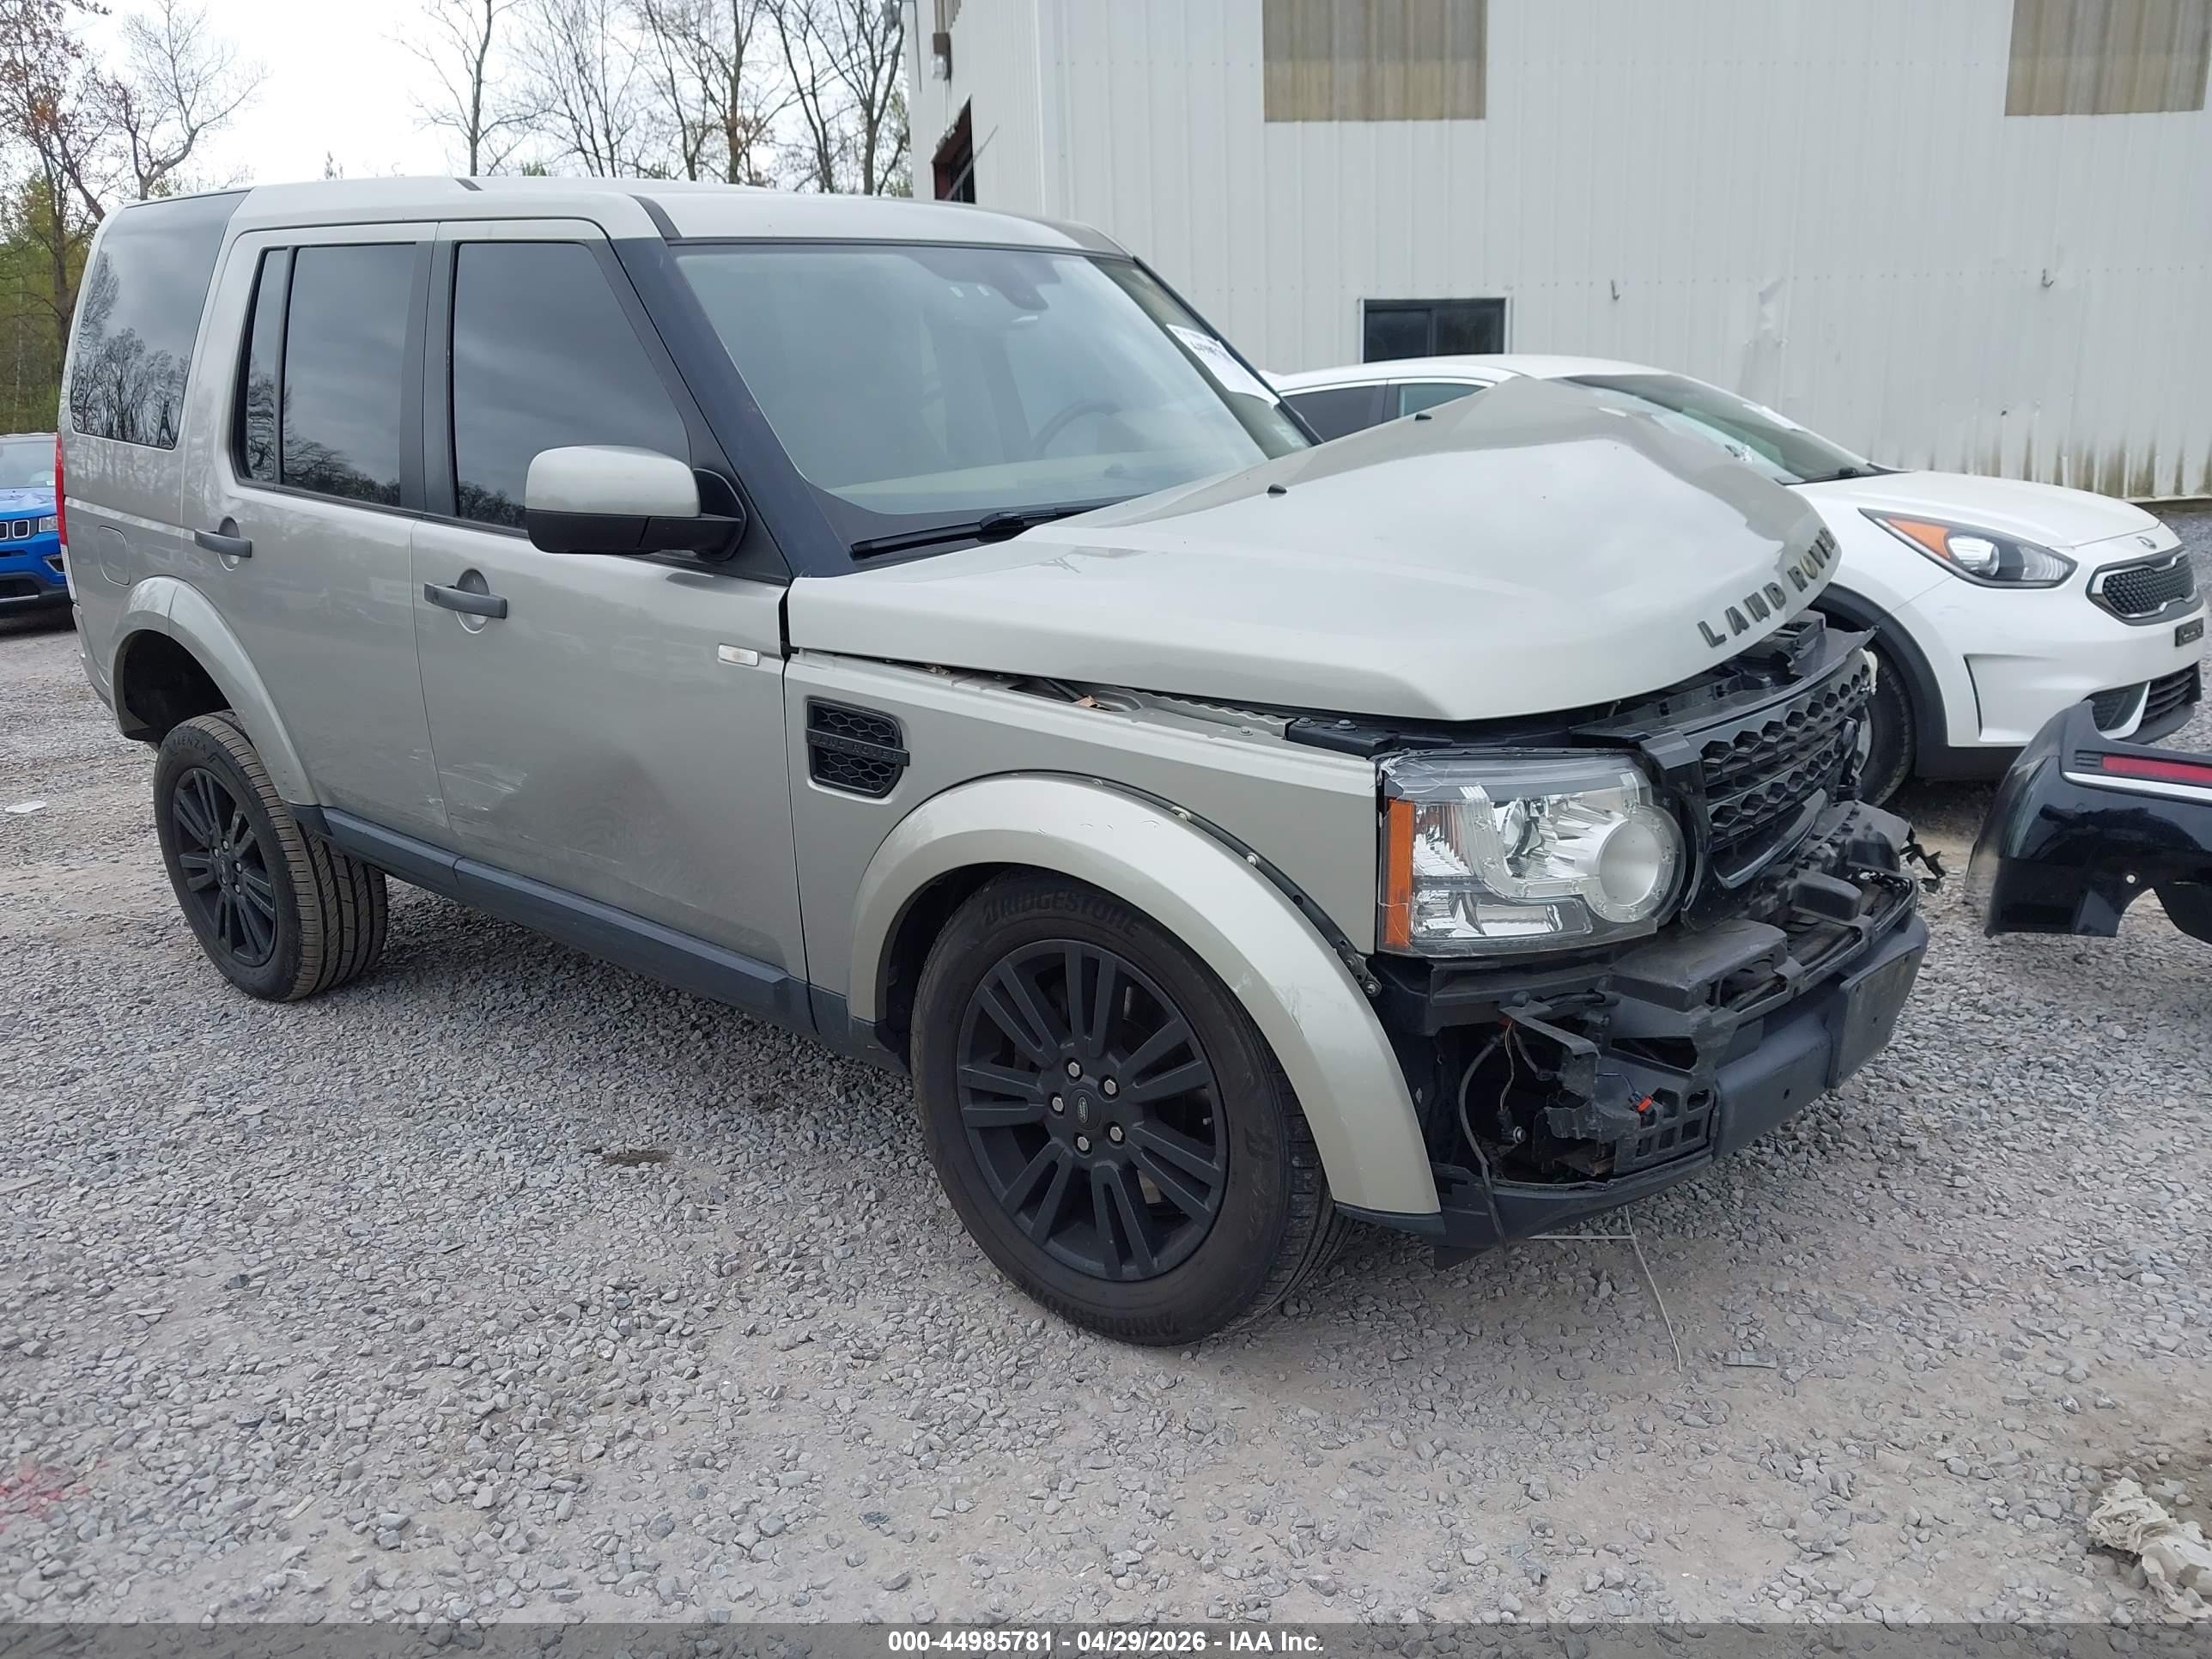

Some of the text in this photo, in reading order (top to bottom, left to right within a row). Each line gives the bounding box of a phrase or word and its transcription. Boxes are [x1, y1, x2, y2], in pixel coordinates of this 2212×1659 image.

[1697, 526, 1836, 647] LAND ROVER
[810, 733, 900, 763] LAND ROVER
